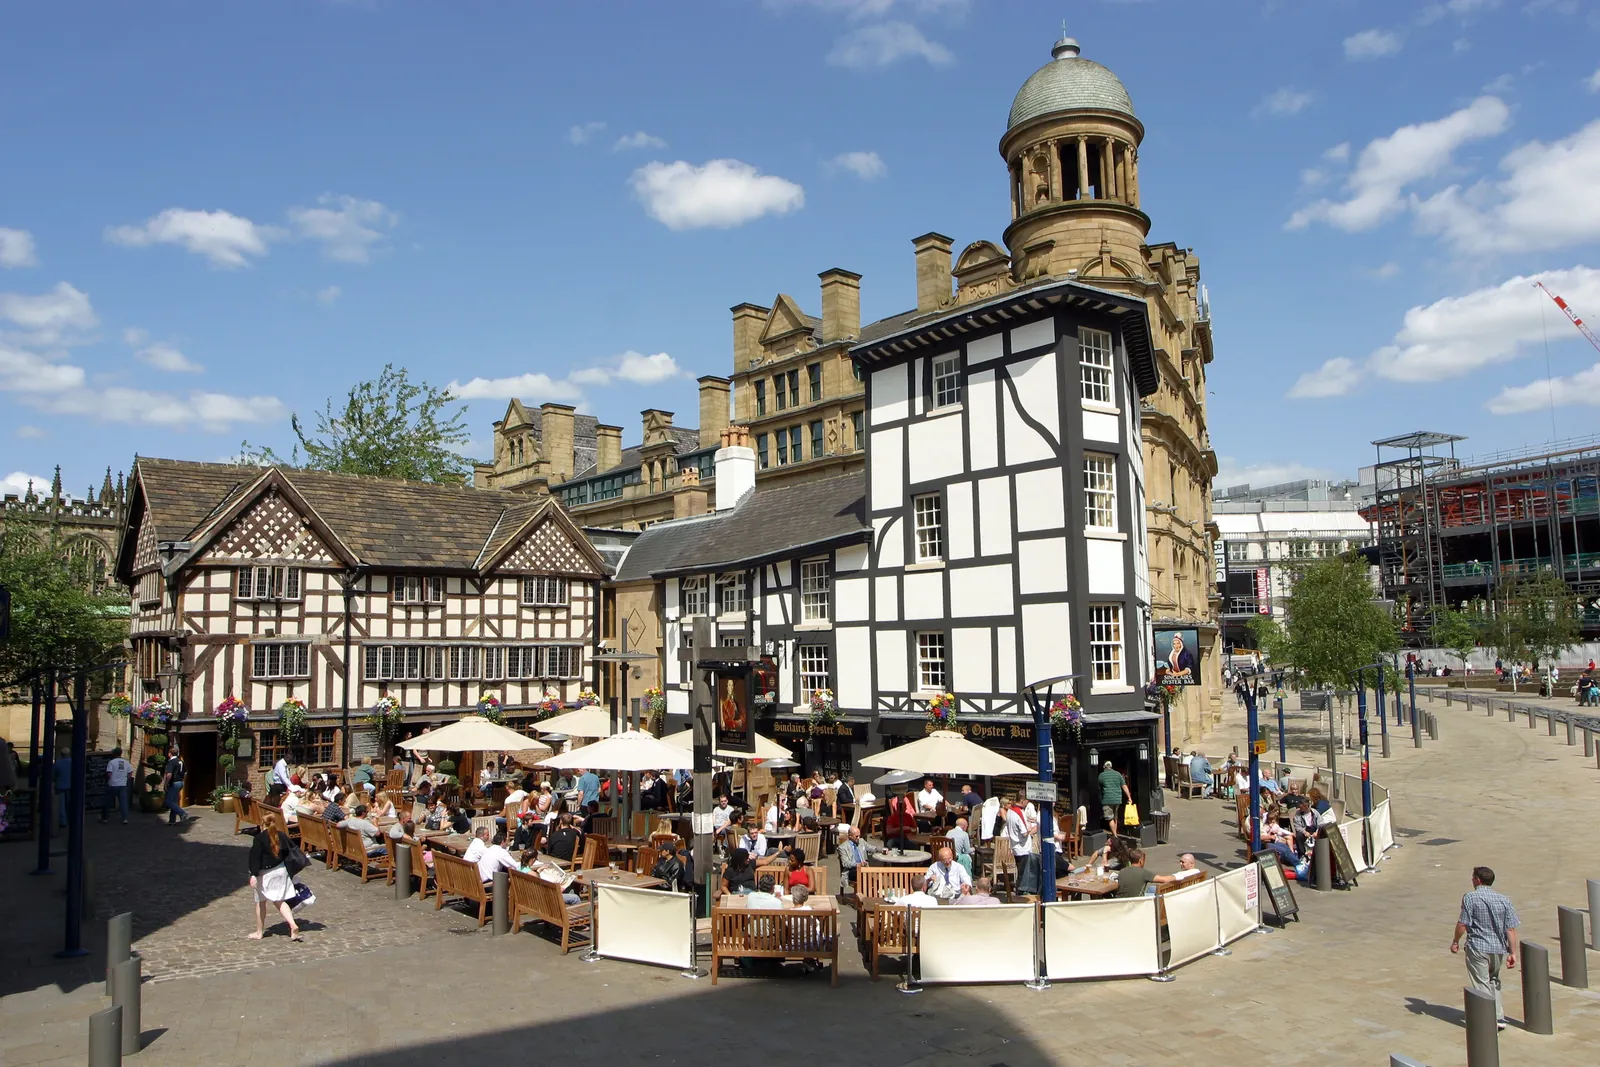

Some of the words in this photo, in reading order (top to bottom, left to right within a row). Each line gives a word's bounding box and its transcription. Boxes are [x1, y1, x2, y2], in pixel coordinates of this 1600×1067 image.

[774, 721, 806, 733] Sinclairs
[808, 724, 834, 736] Oyster
[837, 724, 853, 736] Bar
[971, 723, 1006, 738] Oyster
[1010, 724, 1031, 738] Bar
